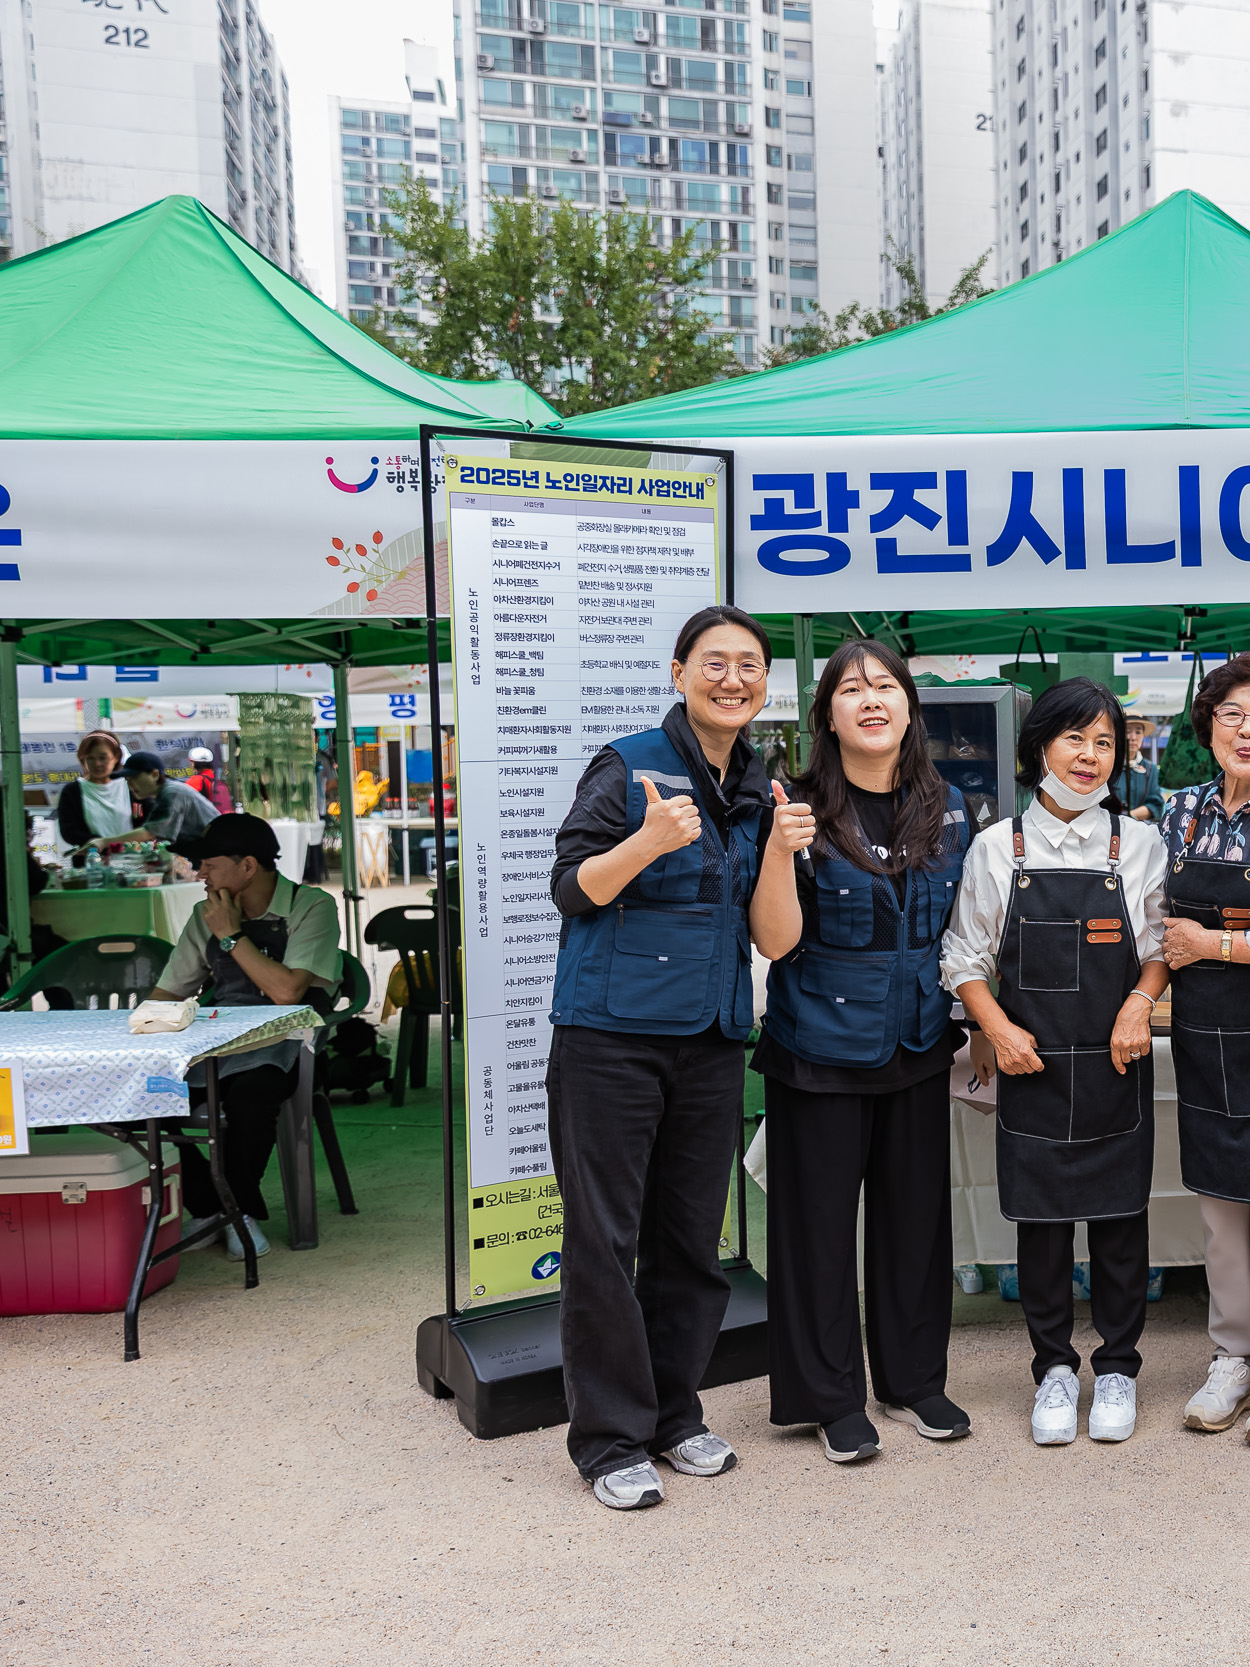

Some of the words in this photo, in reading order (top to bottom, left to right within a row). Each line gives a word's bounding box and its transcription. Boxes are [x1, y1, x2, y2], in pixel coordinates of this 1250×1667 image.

[104, 25, 150, 48] 212
[460, 466, 540, 489] 2025년
[545, 471, 633, 496] 노인일자리
[636, 477, 705, 500] 사업안내
[494, 613, 547, 624] 아름다운자전거
[498, 766, 559, 777] 기타복지시설지원
[499, 787, 545, 798] 노인시설지원
[500, 807, 545, 818] 보육시설지원
[501, 851, 524, 861] 우체국
[524, 849, 558, 860] 행정업무
[505, 996, 543, 1009] 치안지킴이
[505, 1017, 536, 1029] 온달유통
[506, 1037, 537, 1050] 건찬맛찬
[506, 1059, 530, 1071] 어울림
[507, 1101, 546, 1115] 아차산택배
[508, 1122, 547, 1136] 오늘도세탁
